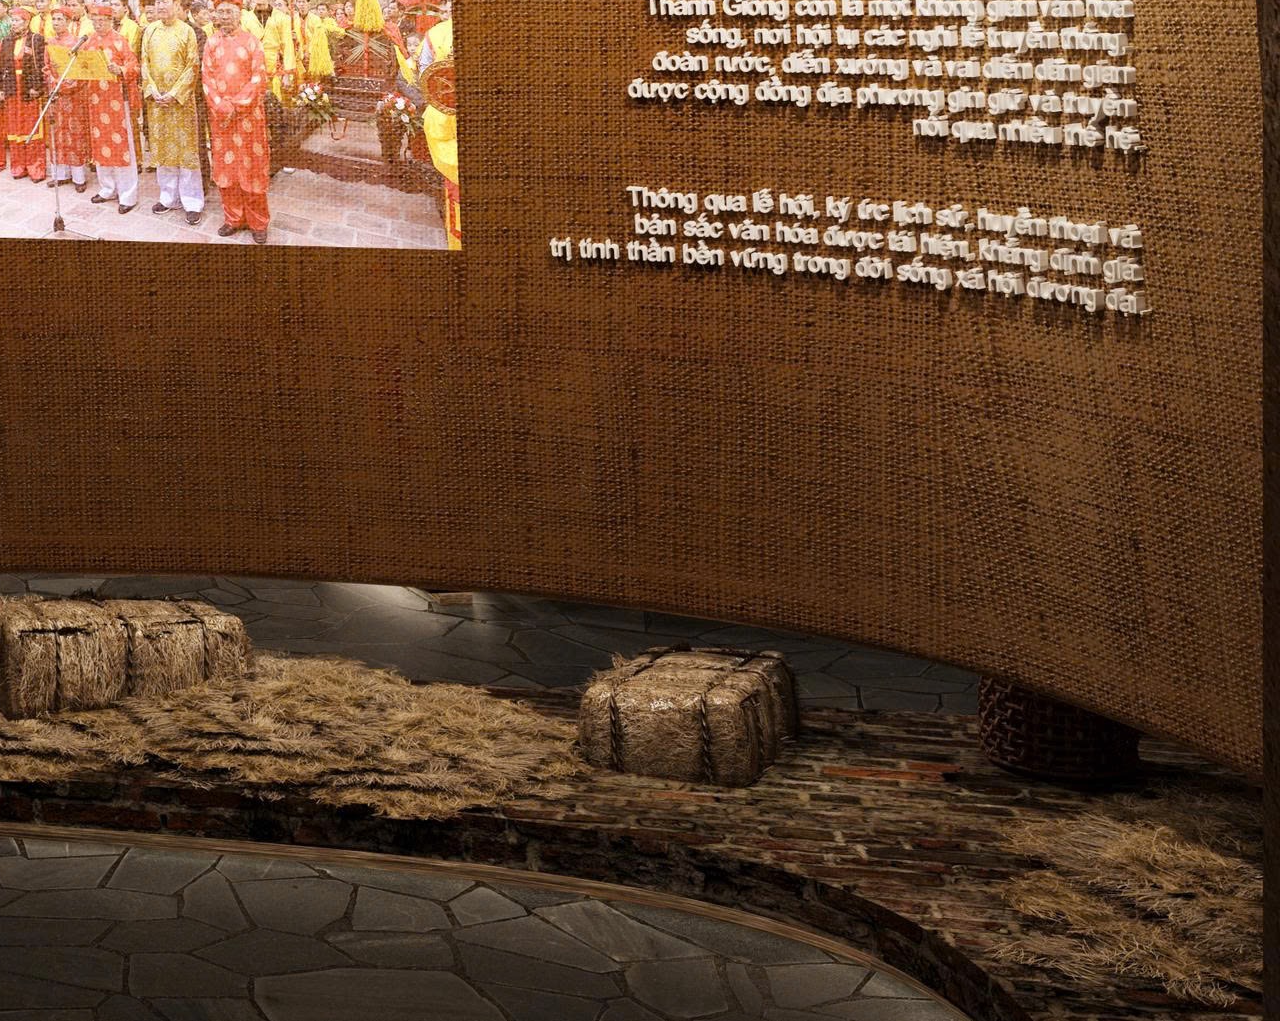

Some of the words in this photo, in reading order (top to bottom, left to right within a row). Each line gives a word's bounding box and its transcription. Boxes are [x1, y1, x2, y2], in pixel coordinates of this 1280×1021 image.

[686, 18, 748, 49] sống,
[754, 22, 791, 45] nơi
[796, 22, 832, 49] hội
[836, 24, 860, 50] tụ
[863, 24, 907, 47] các
[652, 50, 709, 72] đoàn
[715, 51, 776, 76] rước,
[781, 48, 831, 74] diễn
[911, 54, 944, 77] và
[627, 77, 691, 103] được
[694, 78, 749, 106] cộng
[754, 75, 812, 108] đồng
[816, 81, 852, 107] địa
[625, 185, 698, 215] Thông
[703, 193, 747, 217] qua
[752, 187, 774, 214] lễ
[779, 193, 820, 220] hội,
[825, 195, 852, 224] ký
[634, 212, 677, 236] bản
[683, 212, 724, 239] sắc
[727, 218, 771, 241] văn
[775, 221, 819, 245] hóa
[823, 224, 885, 252] được
[549, 237, 572, 262] trị
[577, 238, 621, 260] tinh
[626, 236, 676, 263] thần
[682, 239, 725, 266] bền
[729, 247, 788, 275] vững
[792, 251, 851, 281] trong
[855, 255, 893, 279] đời
[896, 255, 953, 291] sống
